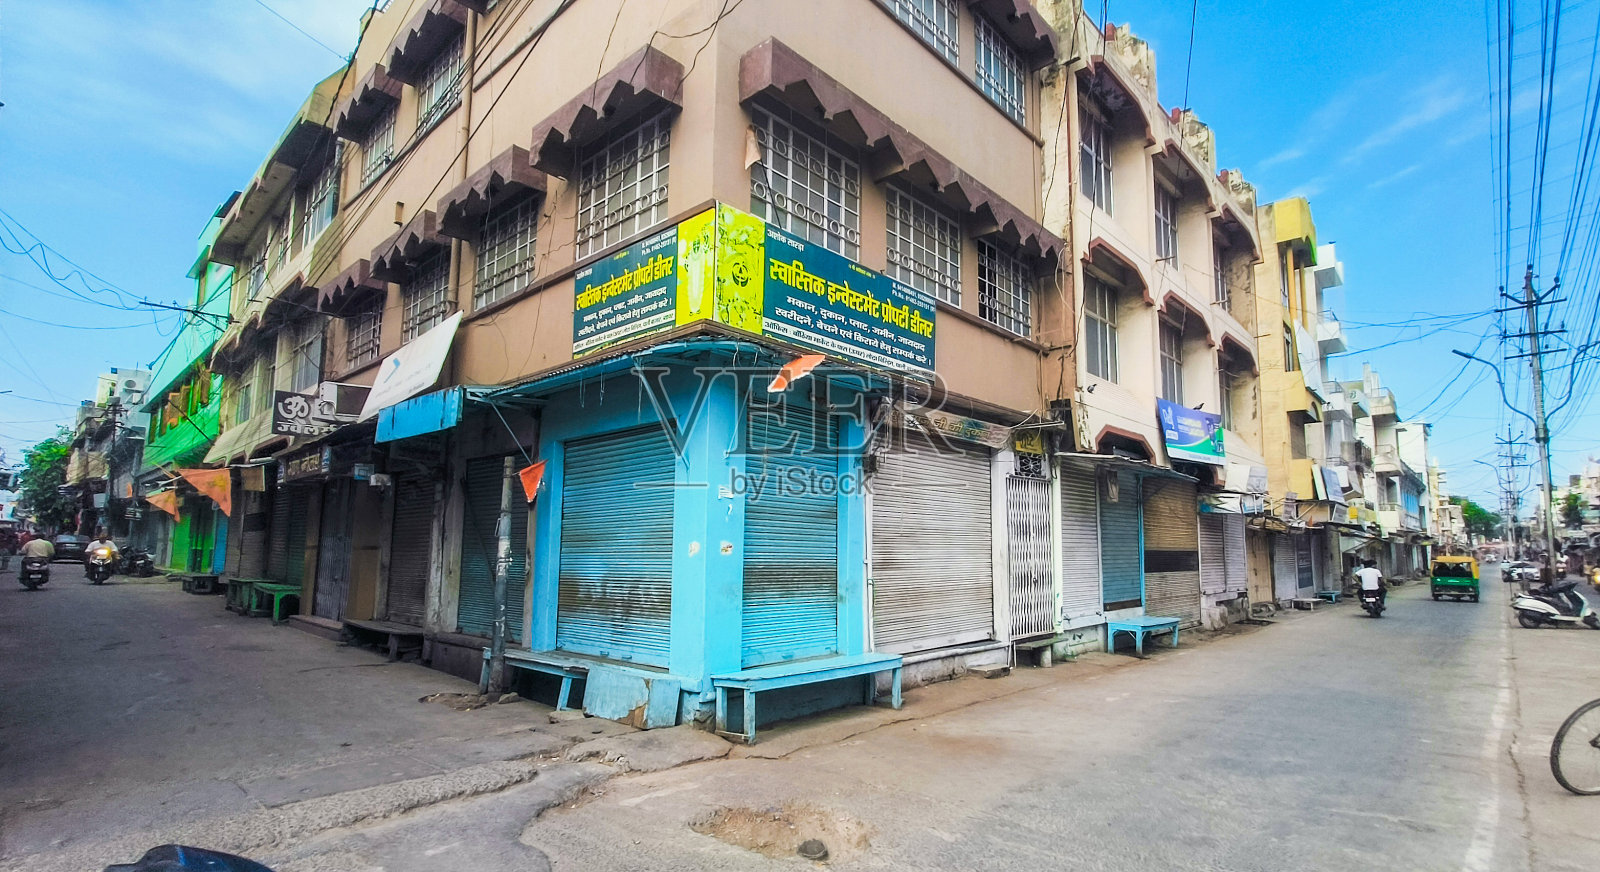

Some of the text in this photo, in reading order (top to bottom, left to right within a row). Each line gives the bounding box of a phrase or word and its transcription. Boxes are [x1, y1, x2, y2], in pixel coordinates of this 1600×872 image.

[770, 258, 826, 297] स्वास्तिक
[828, 280, 880, 318] इन्वेस्टमेंट
[910, 310, 933, 339] डीलर
[787, 296, 818, 315] मकान,
[820, 308, 847, 325] दुकान,
[872, 327, 896, 342] जमीन,
[898, 336, 925, 352] जायदाद
